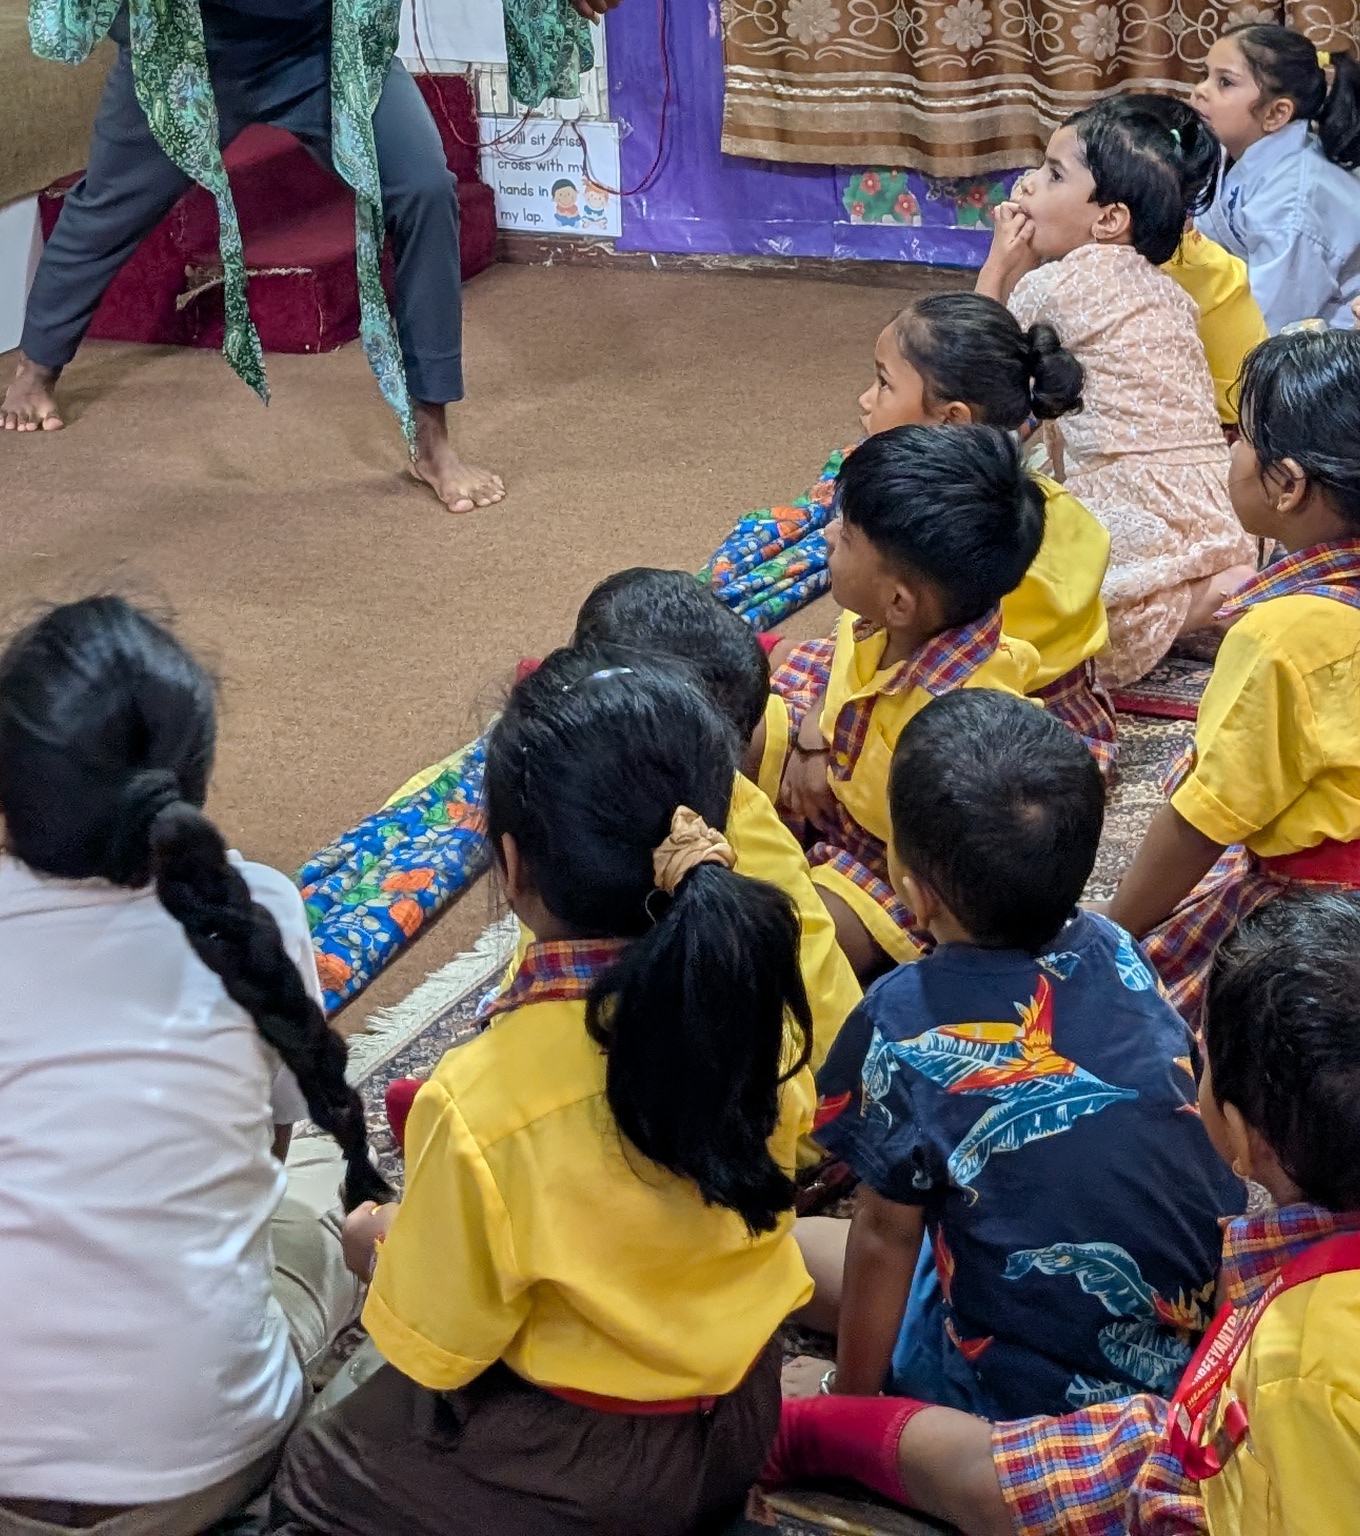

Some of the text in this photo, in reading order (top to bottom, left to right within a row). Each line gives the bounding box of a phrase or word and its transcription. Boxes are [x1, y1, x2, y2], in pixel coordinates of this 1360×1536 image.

[507, 130, 526, 145] will
[530, 133, 546, 146] sit
[552, 135, 582, 147] criss
[497, 160, 531, 171] cross
[536, 158, 564, 172] with
[498, 180, 549, 197] hands in
[500, 207, 544, 225] my lap.
